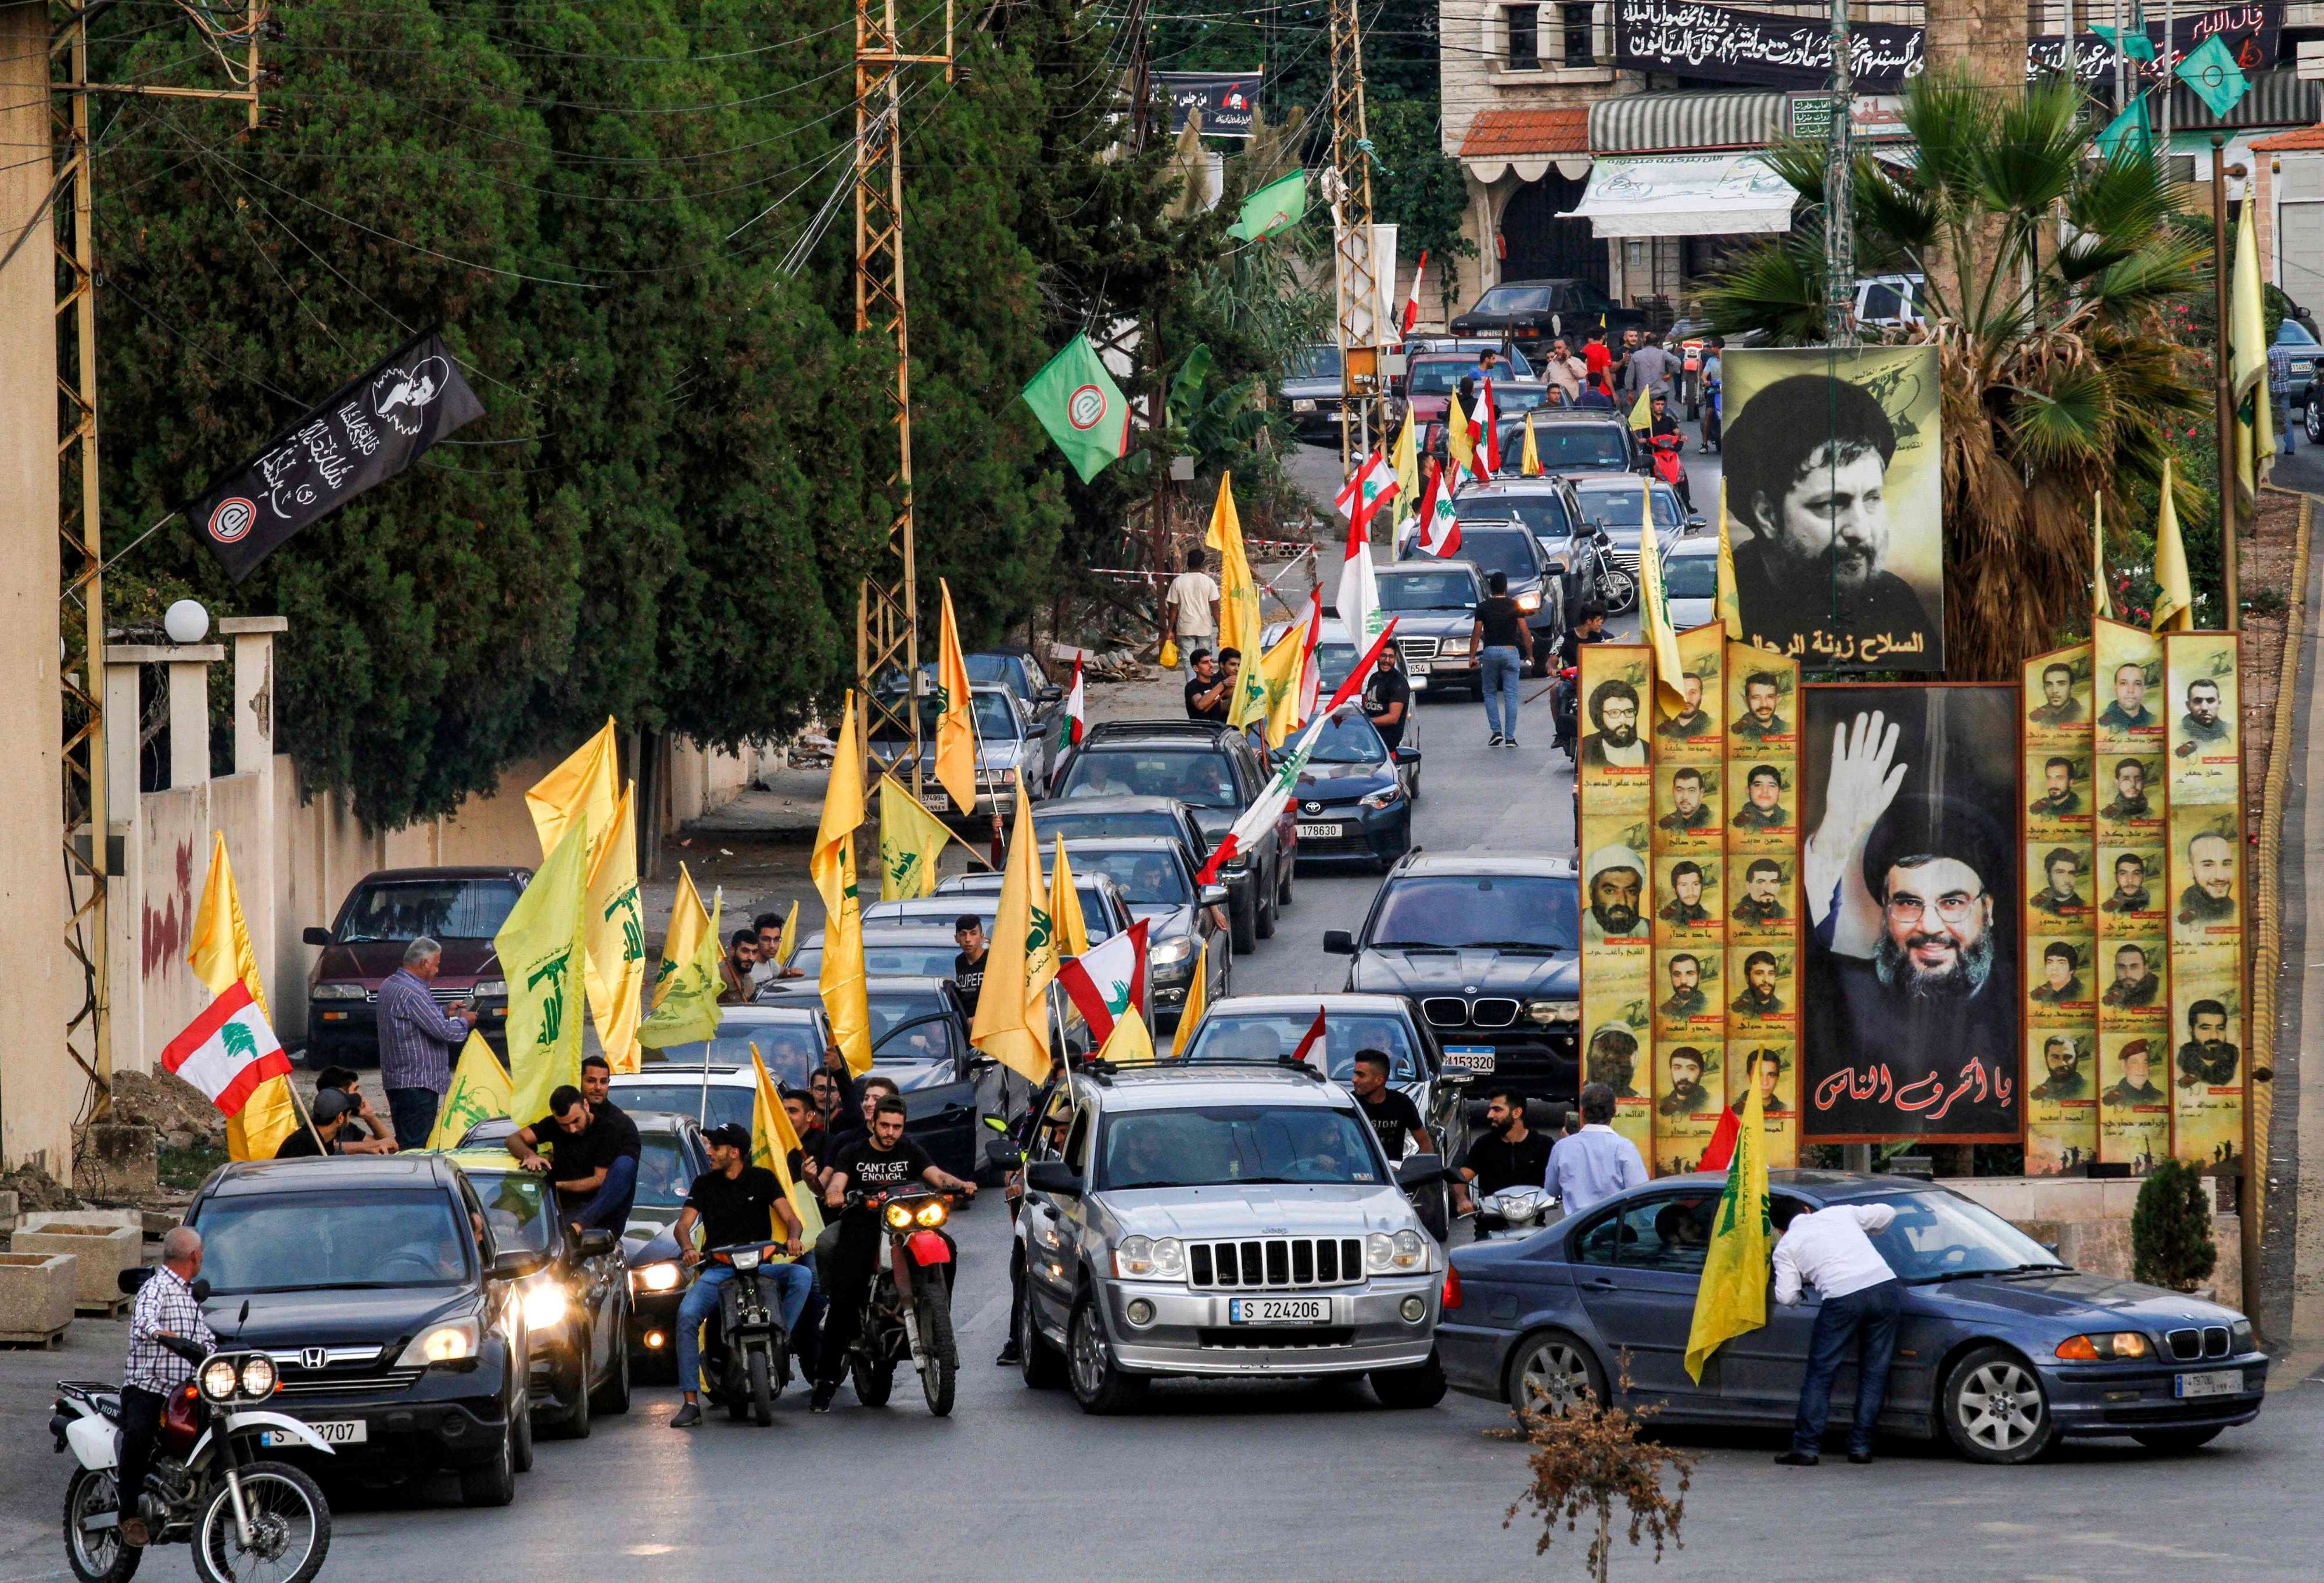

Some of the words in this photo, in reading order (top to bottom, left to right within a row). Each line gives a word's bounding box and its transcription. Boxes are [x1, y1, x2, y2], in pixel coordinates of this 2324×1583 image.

[1812, 631, 1855, 661] زينة
[1860, 632, 1925, 662] السلاح
[1303, 825, 1336, 836] 178630
[1814, 1063, 1893, 1111] الناس
[1995, 1066, 2012, 1108] يا
[888, 1161, 909, 1172] GET
[1261, 1226, 1289, 1235] Jeep
[1244, 1302, 1254, 1319] S
[1264, 1302, 1320, 1319] 224206
